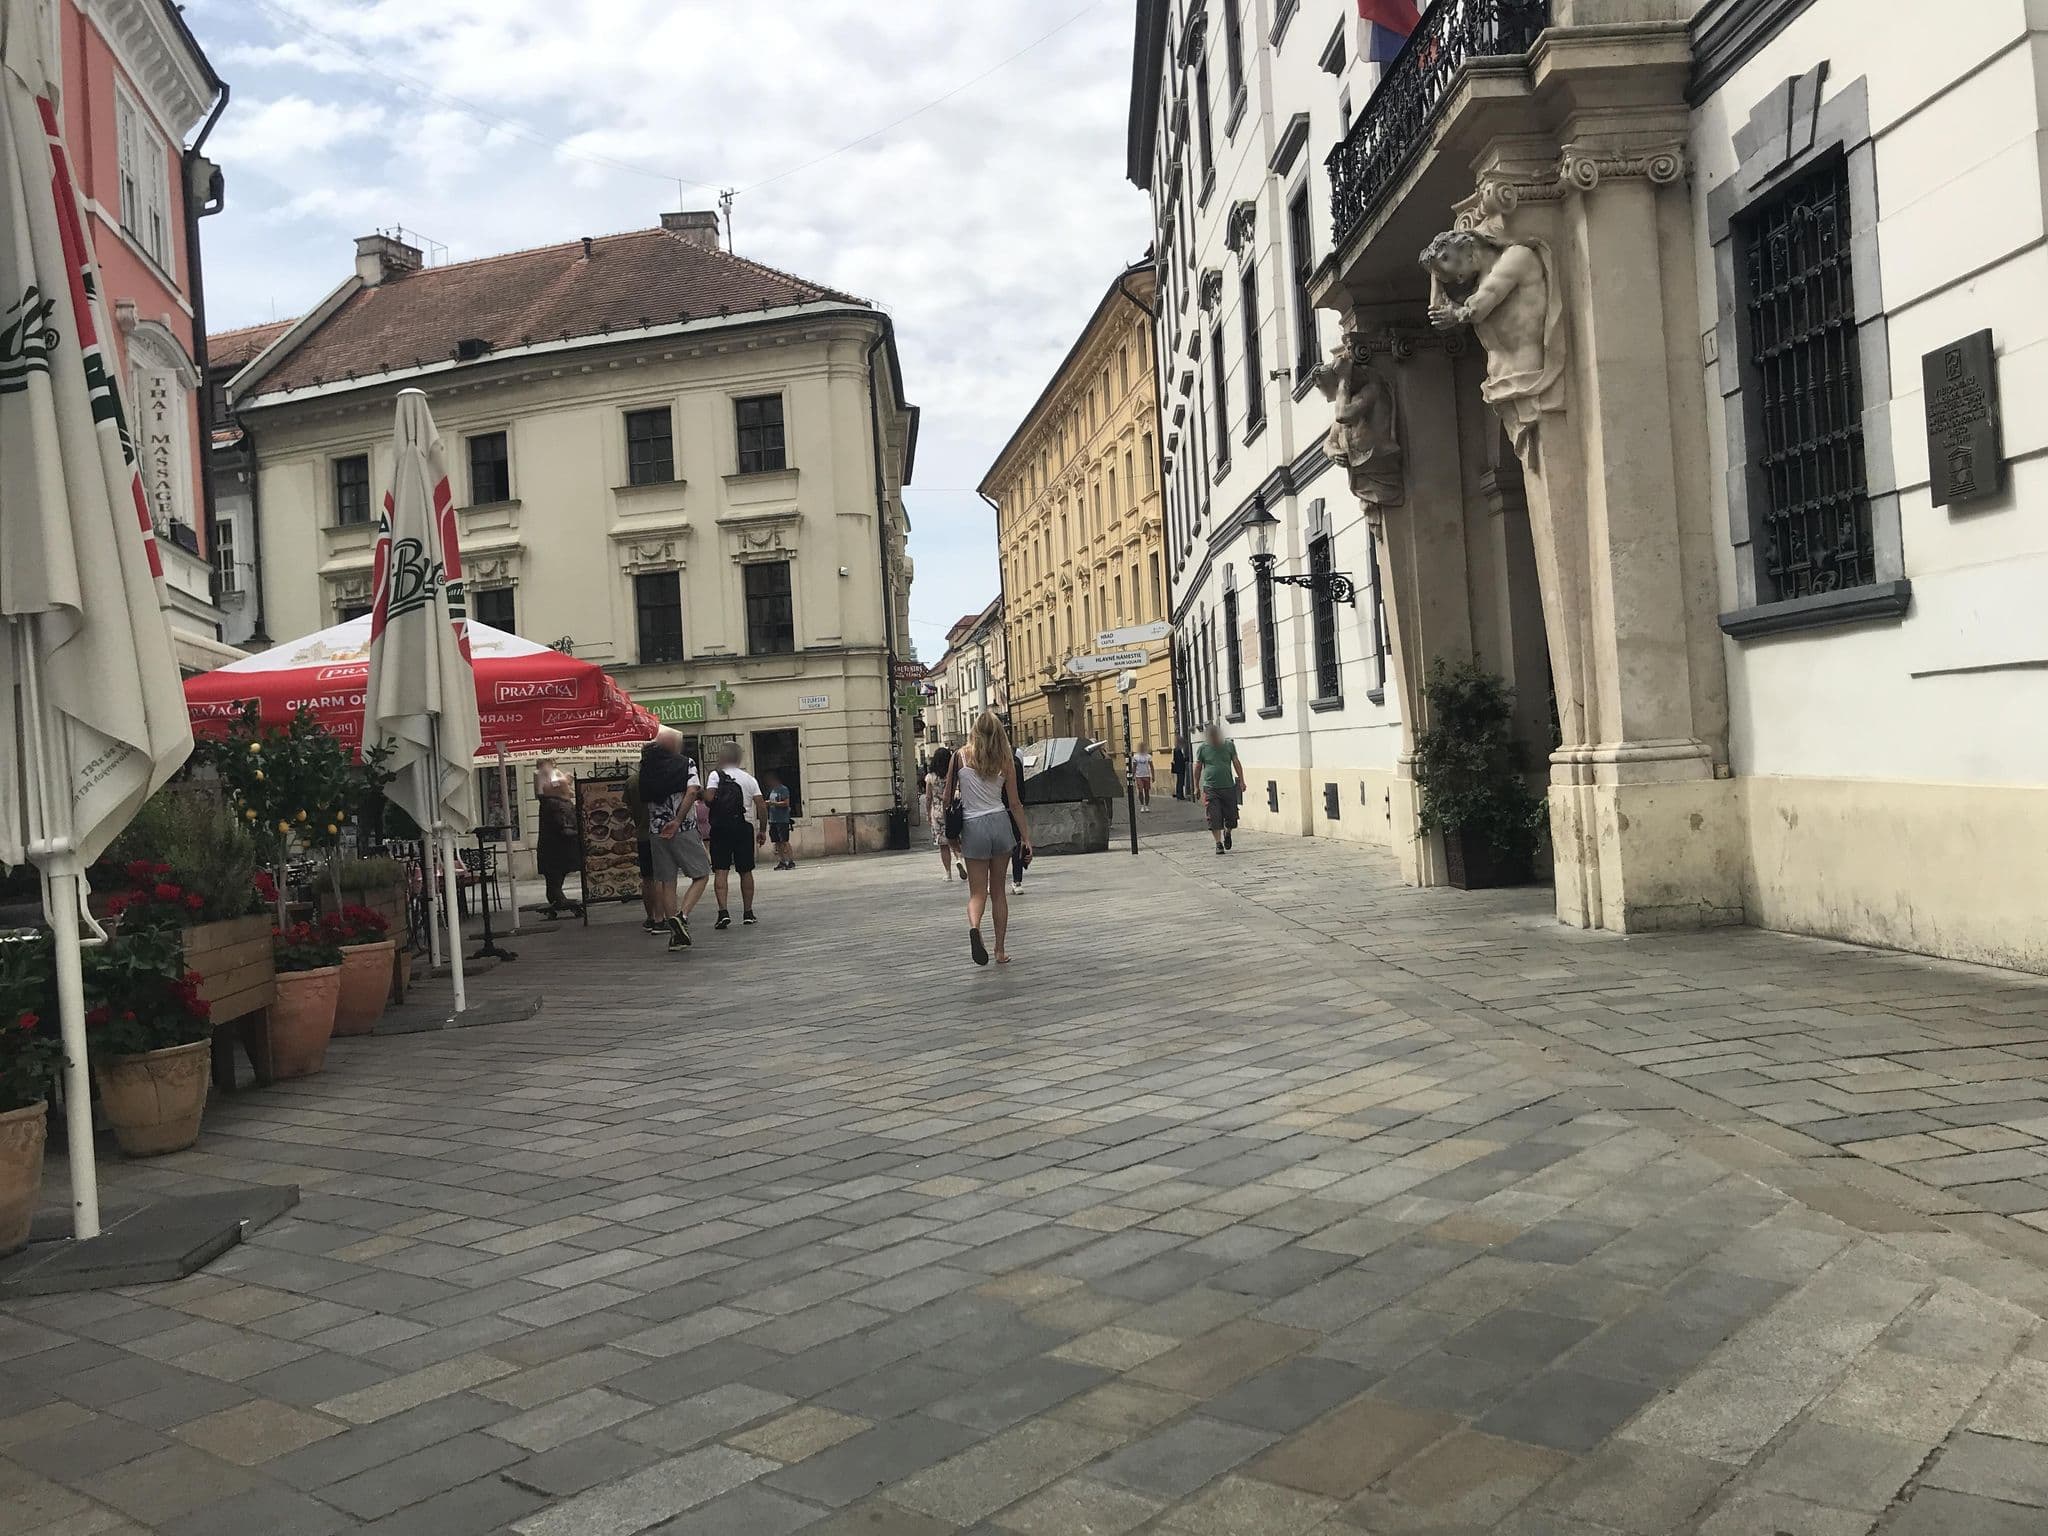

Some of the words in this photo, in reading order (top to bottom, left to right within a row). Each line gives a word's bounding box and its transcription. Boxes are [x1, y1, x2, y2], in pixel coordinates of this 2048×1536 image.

[150, 377, 167, 421] THAI
[151, 434, 173, 512] MASSAGE
[1100, 632, 1114, 640] HRAD
[1095, 654, 1116, 663] HLAVNÉ
[1116, 652, 1142, 661] NÁMESTIE
[500, 683, 573, 700] PRAŽAČKA
[286, 695, 345, 711] CHARM
[647, 701, 703, 721] ekáreň
